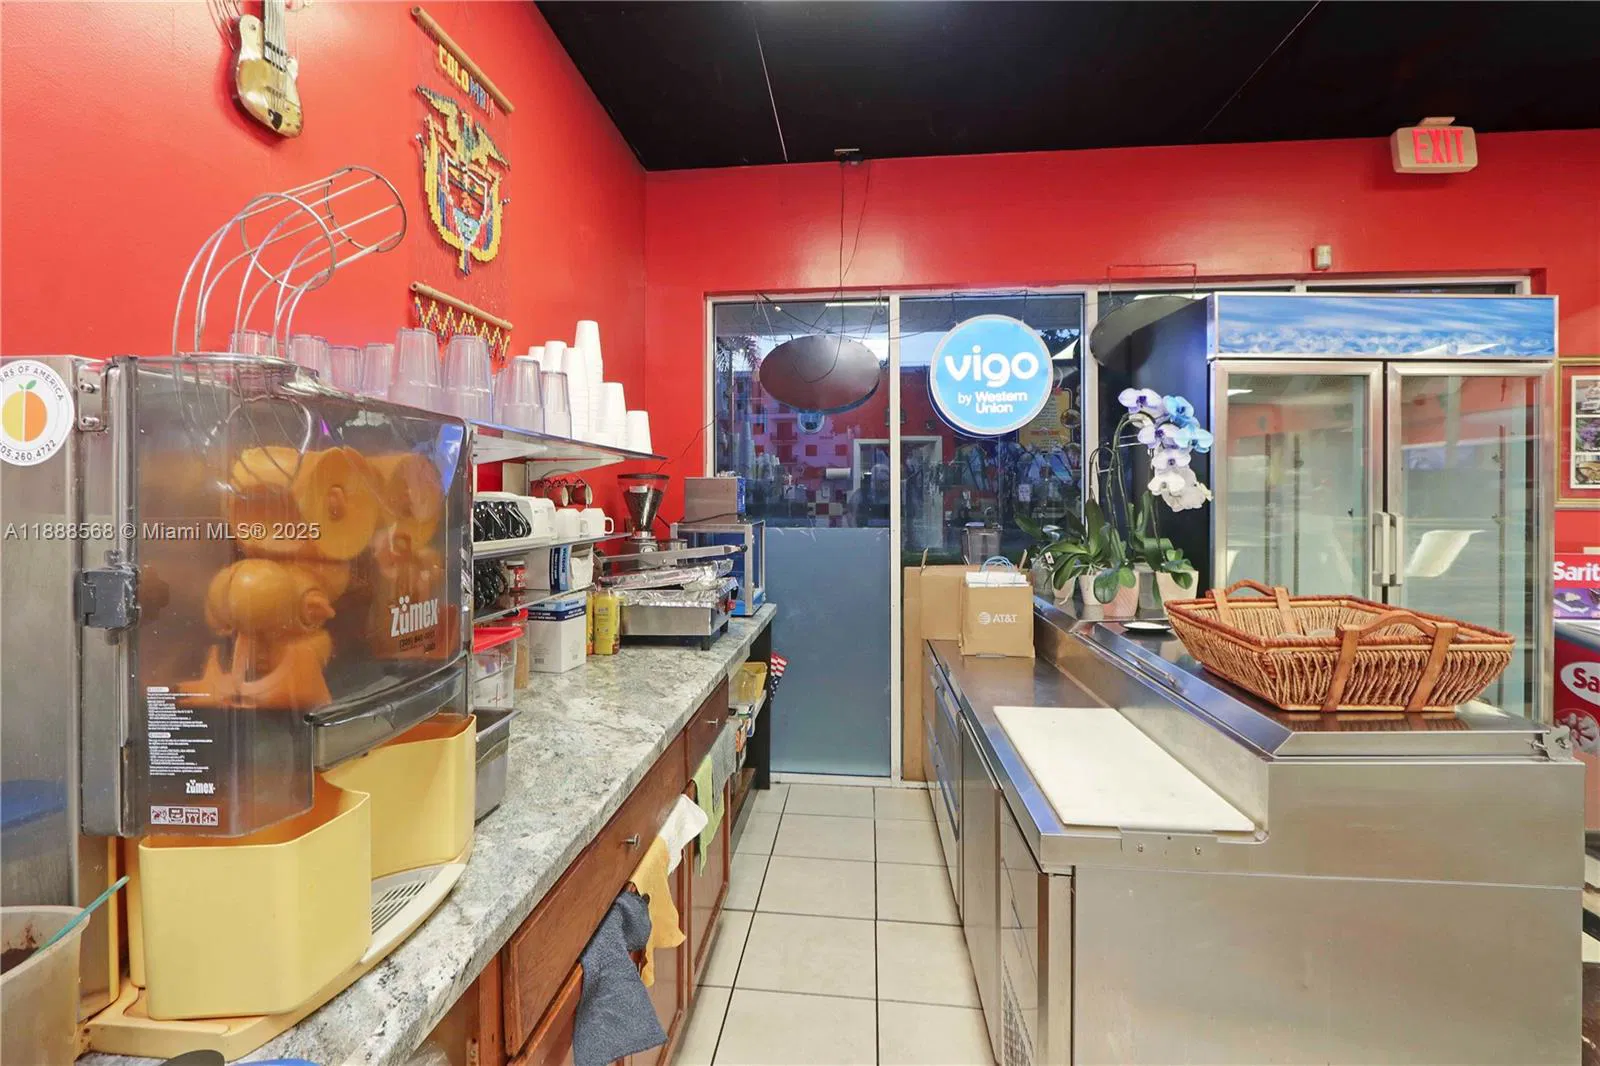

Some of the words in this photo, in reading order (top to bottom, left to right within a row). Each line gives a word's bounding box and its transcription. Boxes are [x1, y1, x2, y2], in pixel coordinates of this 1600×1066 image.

[439, 44, 496, 120] COLOMBIA
[1412, 128, 1465, 165] EXIT
[944, 345, 1039, 388] vigo
[18, 365, 30, 375] OF
[33, 366, 64, 401] AMERICA
[957, 392, 972, 406] by
[975, 391, 1028, 402] Western
[976, 402, 1013, 414] Union
[992, 613, 1017, 623] AT&T
[1573, 667, 1600, 693] Sa
